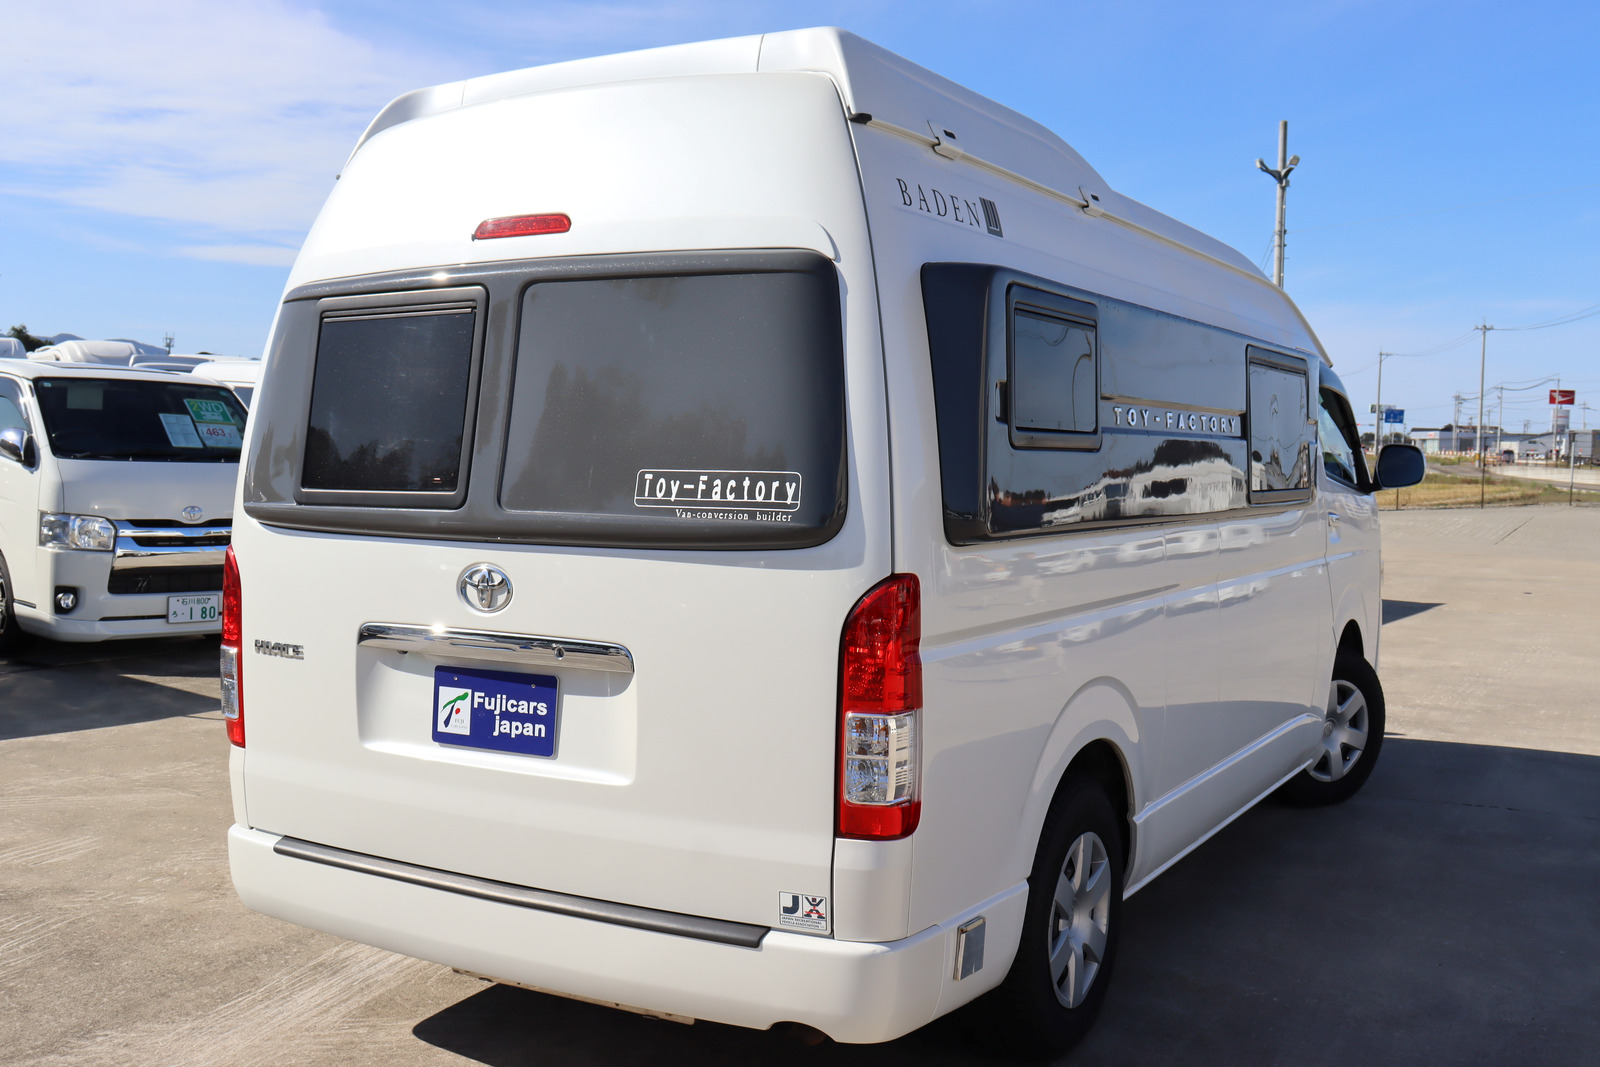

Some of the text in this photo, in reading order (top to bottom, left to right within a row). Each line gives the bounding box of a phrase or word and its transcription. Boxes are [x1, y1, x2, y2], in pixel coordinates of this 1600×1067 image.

[896, 178, 981, 228] BADEN
[189, 401, 223, 413] 2WD
[1113, 406, 1236, 433] TOY-FACTORY
[206, 427, 226, 437] 463
[644, 473, 796, 505] Toy-Factory
[675, 509, 792, 522] Van-conversion builder
[473, 691, 548, 716] Fujicars
[493, 716, 546, 738] japan
